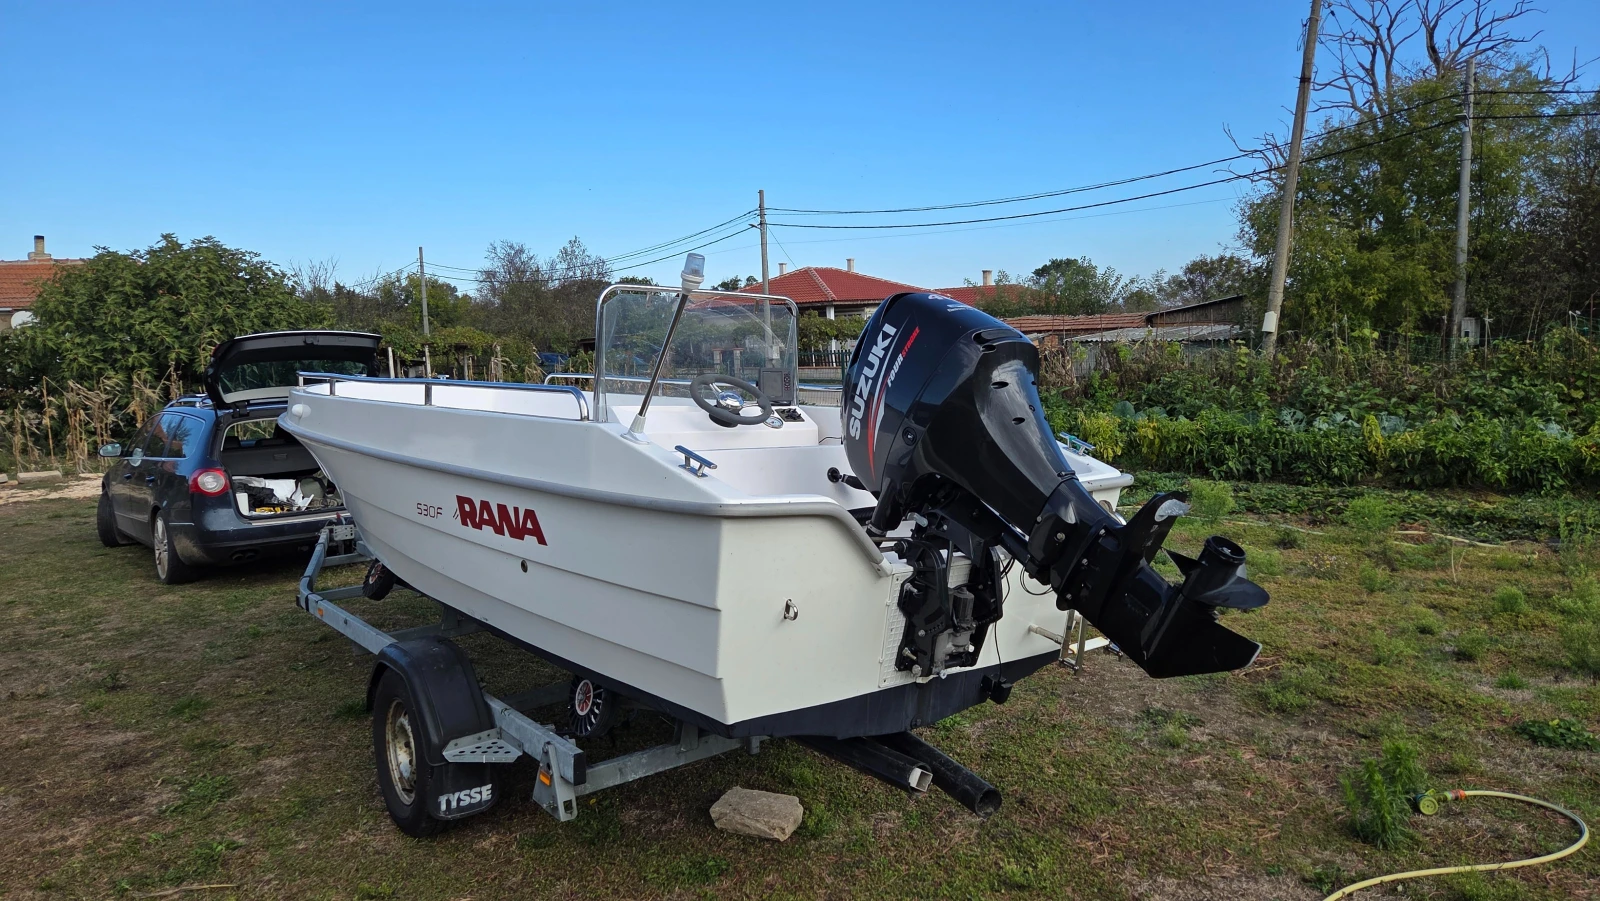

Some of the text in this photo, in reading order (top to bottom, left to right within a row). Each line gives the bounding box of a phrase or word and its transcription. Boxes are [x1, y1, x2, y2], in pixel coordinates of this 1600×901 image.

[850, 324, 897, 440] SUZUKI
[417, 503, 442, 519] 530F
[457, 495, 547, 546] RANA
[438, 784, 492, 811] TYSSE
